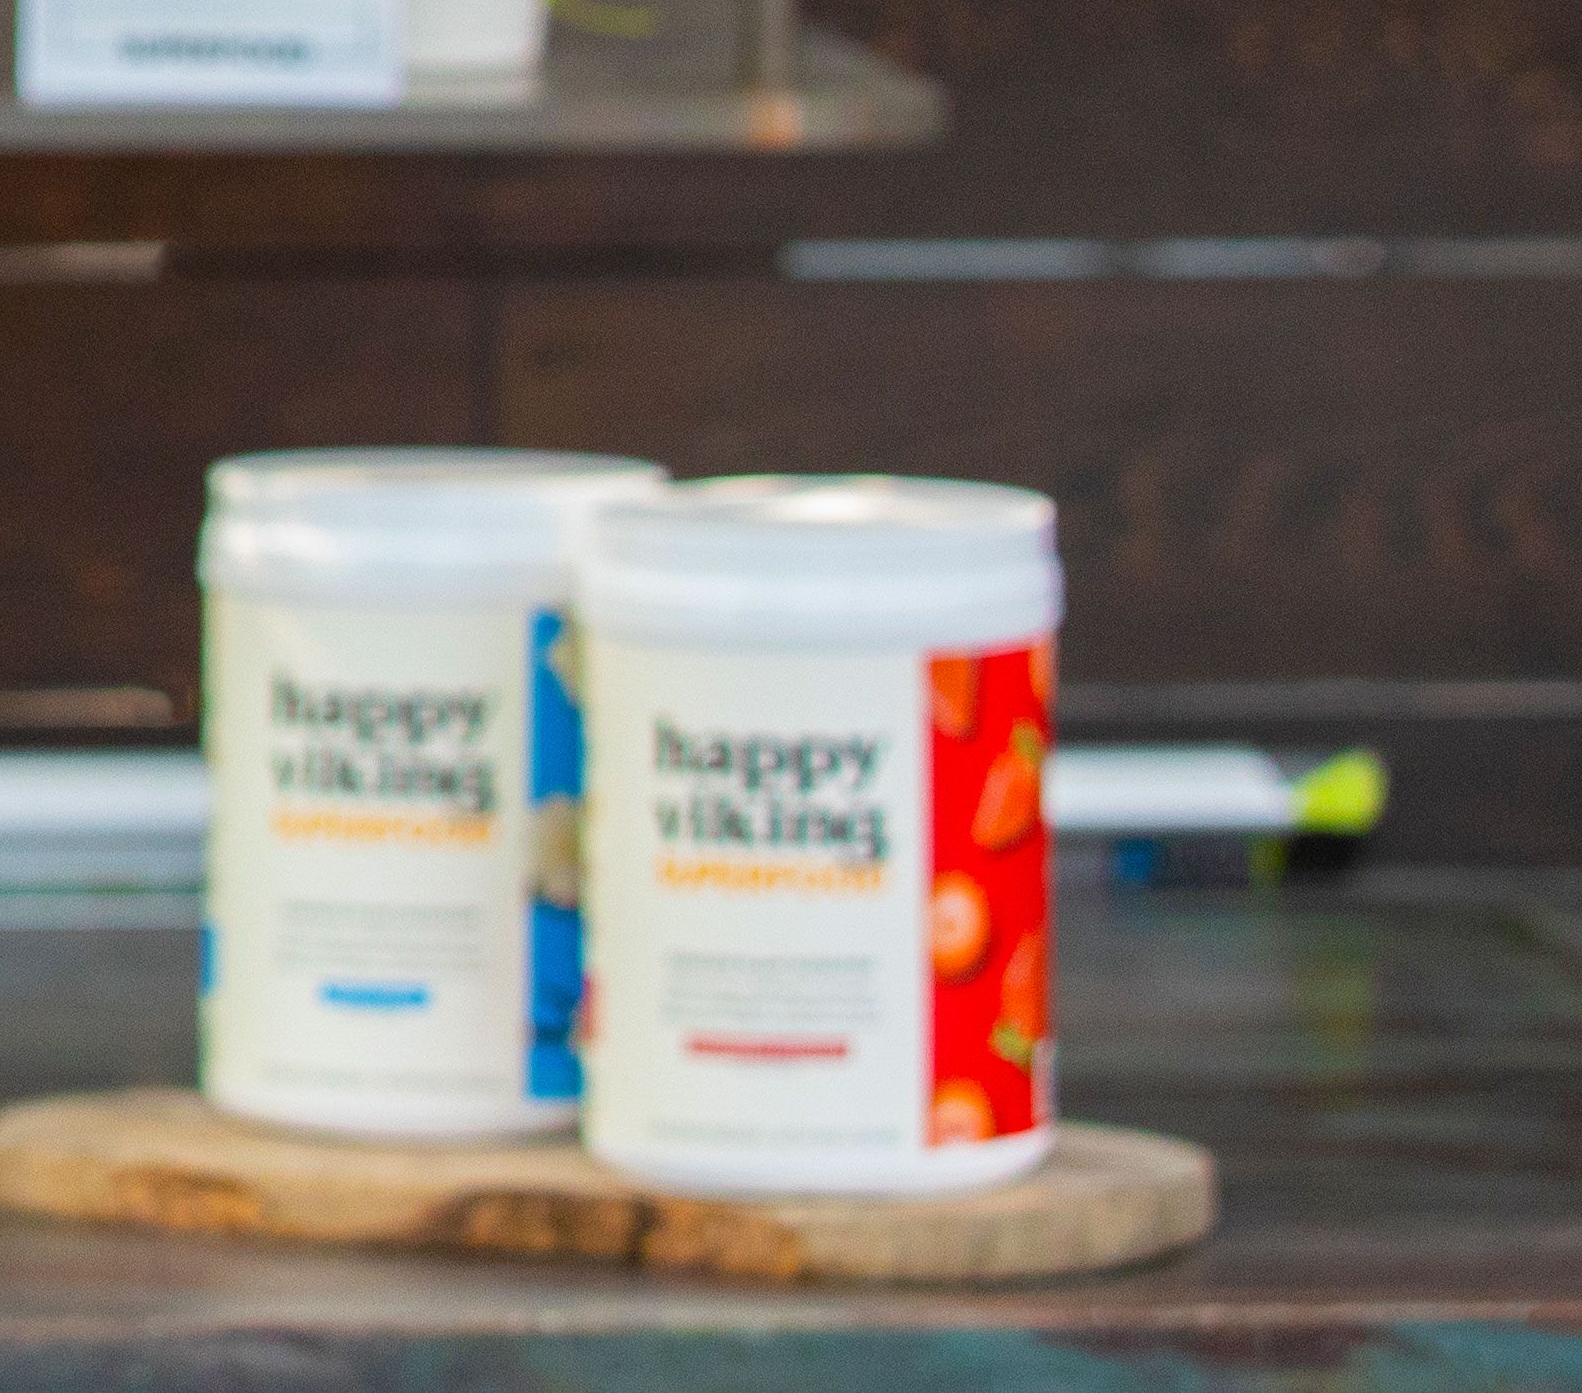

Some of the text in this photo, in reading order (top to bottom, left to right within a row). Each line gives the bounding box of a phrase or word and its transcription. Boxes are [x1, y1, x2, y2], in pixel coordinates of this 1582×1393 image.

[272, 669, 496, 746] happy
[657, 718, 890, 794] happy
[657, 793, 891, 866] viking
